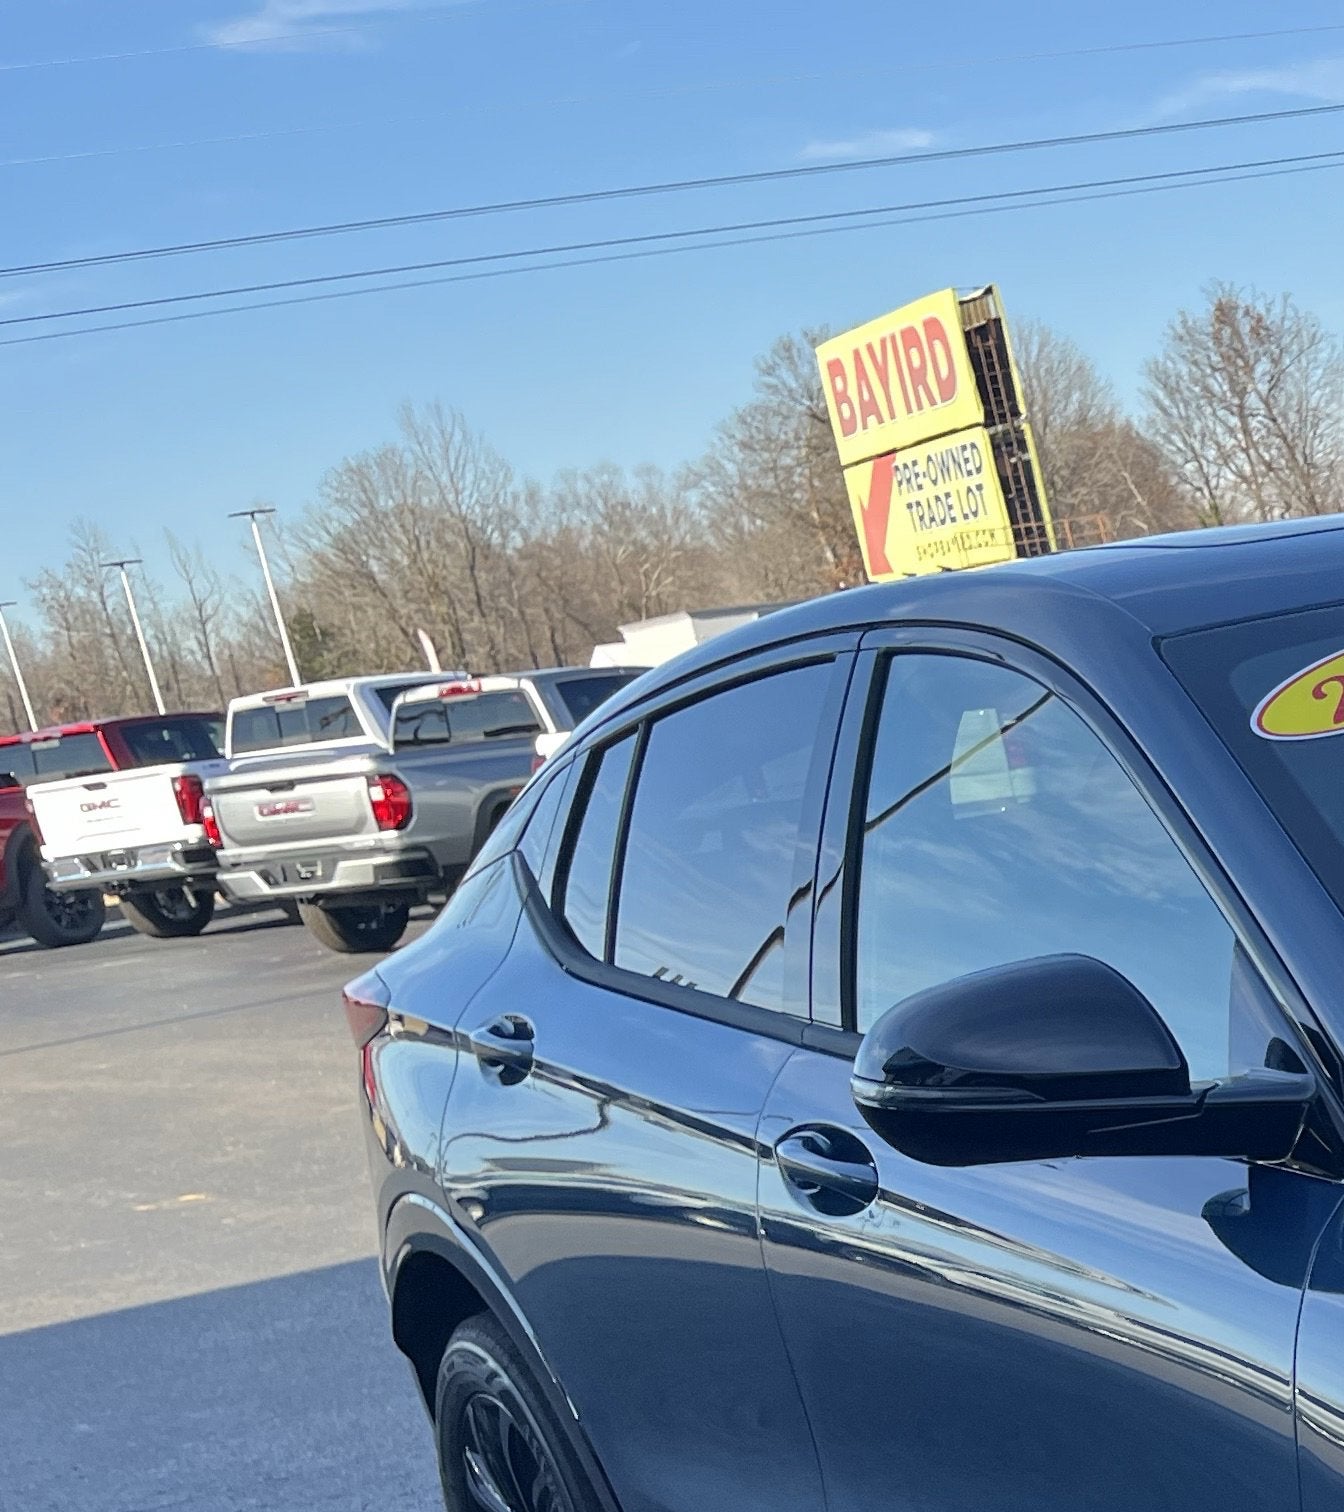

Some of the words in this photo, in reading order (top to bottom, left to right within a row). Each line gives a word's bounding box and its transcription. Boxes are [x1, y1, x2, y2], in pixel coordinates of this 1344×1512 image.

[827, 316, 957, 437] BAYIRD
[893, 441, 983, 496] PRE-OWNED
[906, 491, 957, 533] TRADE
[959, 483, 989, 521] LOT
